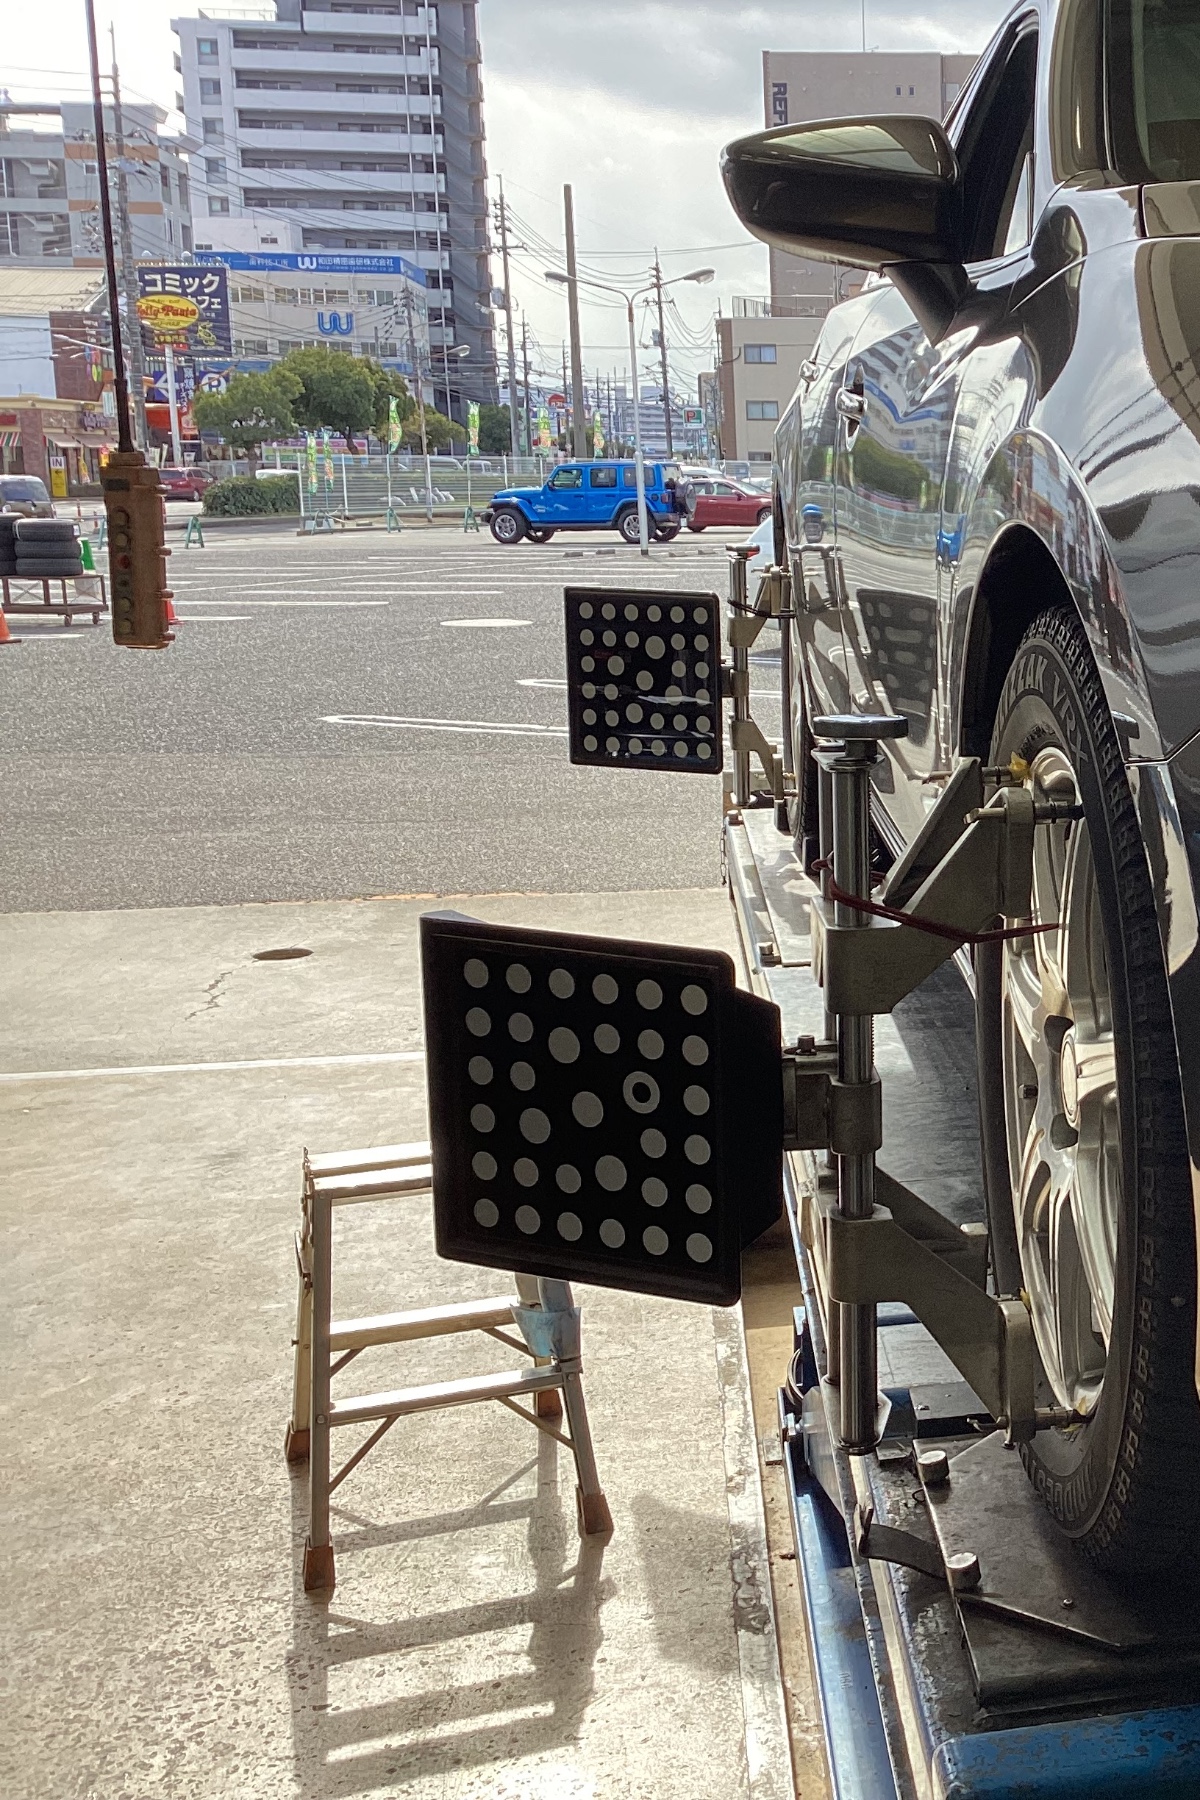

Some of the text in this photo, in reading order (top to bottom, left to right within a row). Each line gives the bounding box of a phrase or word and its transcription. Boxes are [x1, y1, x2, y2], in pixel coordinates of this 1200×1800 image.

[772, 83, 788, 127] REF
[144, 273, 220, 293] コミック
[53, 457, 63, 468] IN
[1053, 671, 1088, 778] VRX
